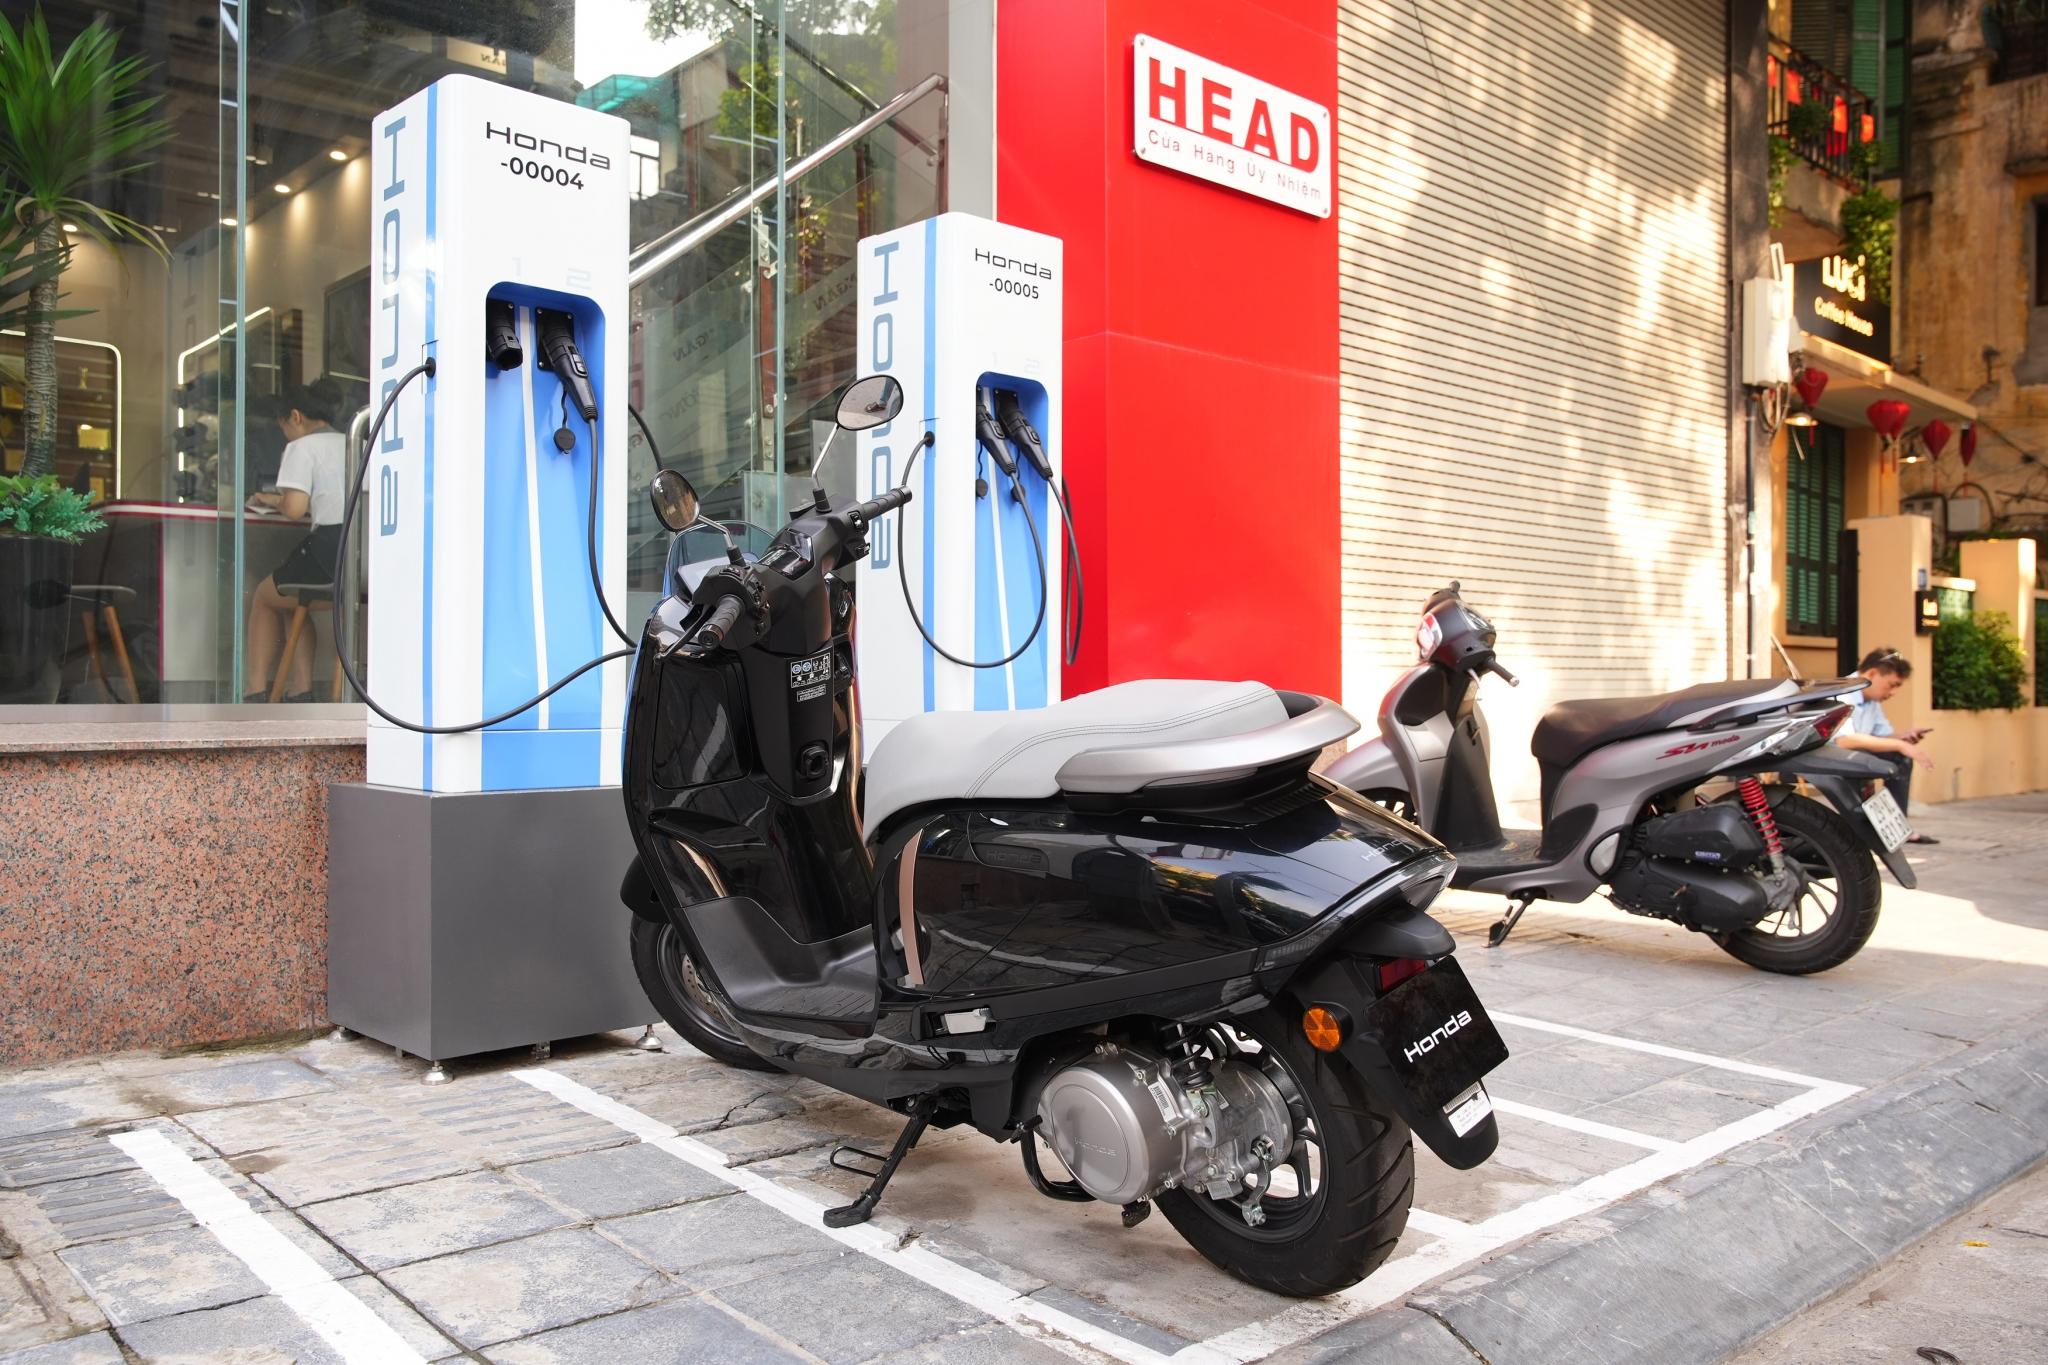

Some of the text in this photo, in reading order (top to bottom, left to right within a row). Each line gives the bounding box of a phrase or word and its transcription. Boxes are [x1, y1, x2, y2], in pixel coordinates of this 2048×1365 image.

[1149, 56, 1319, 174] HEAD
[486, 121, 611, 170] Honda
[501, 157, 584, 189] -00004
[975, 248, 1052, 280] Honda
[989, 278, 1039, 300] -00005
[380, 116, 406, 537] Honda
[1404, 1010, 1473, 1063] Honda
